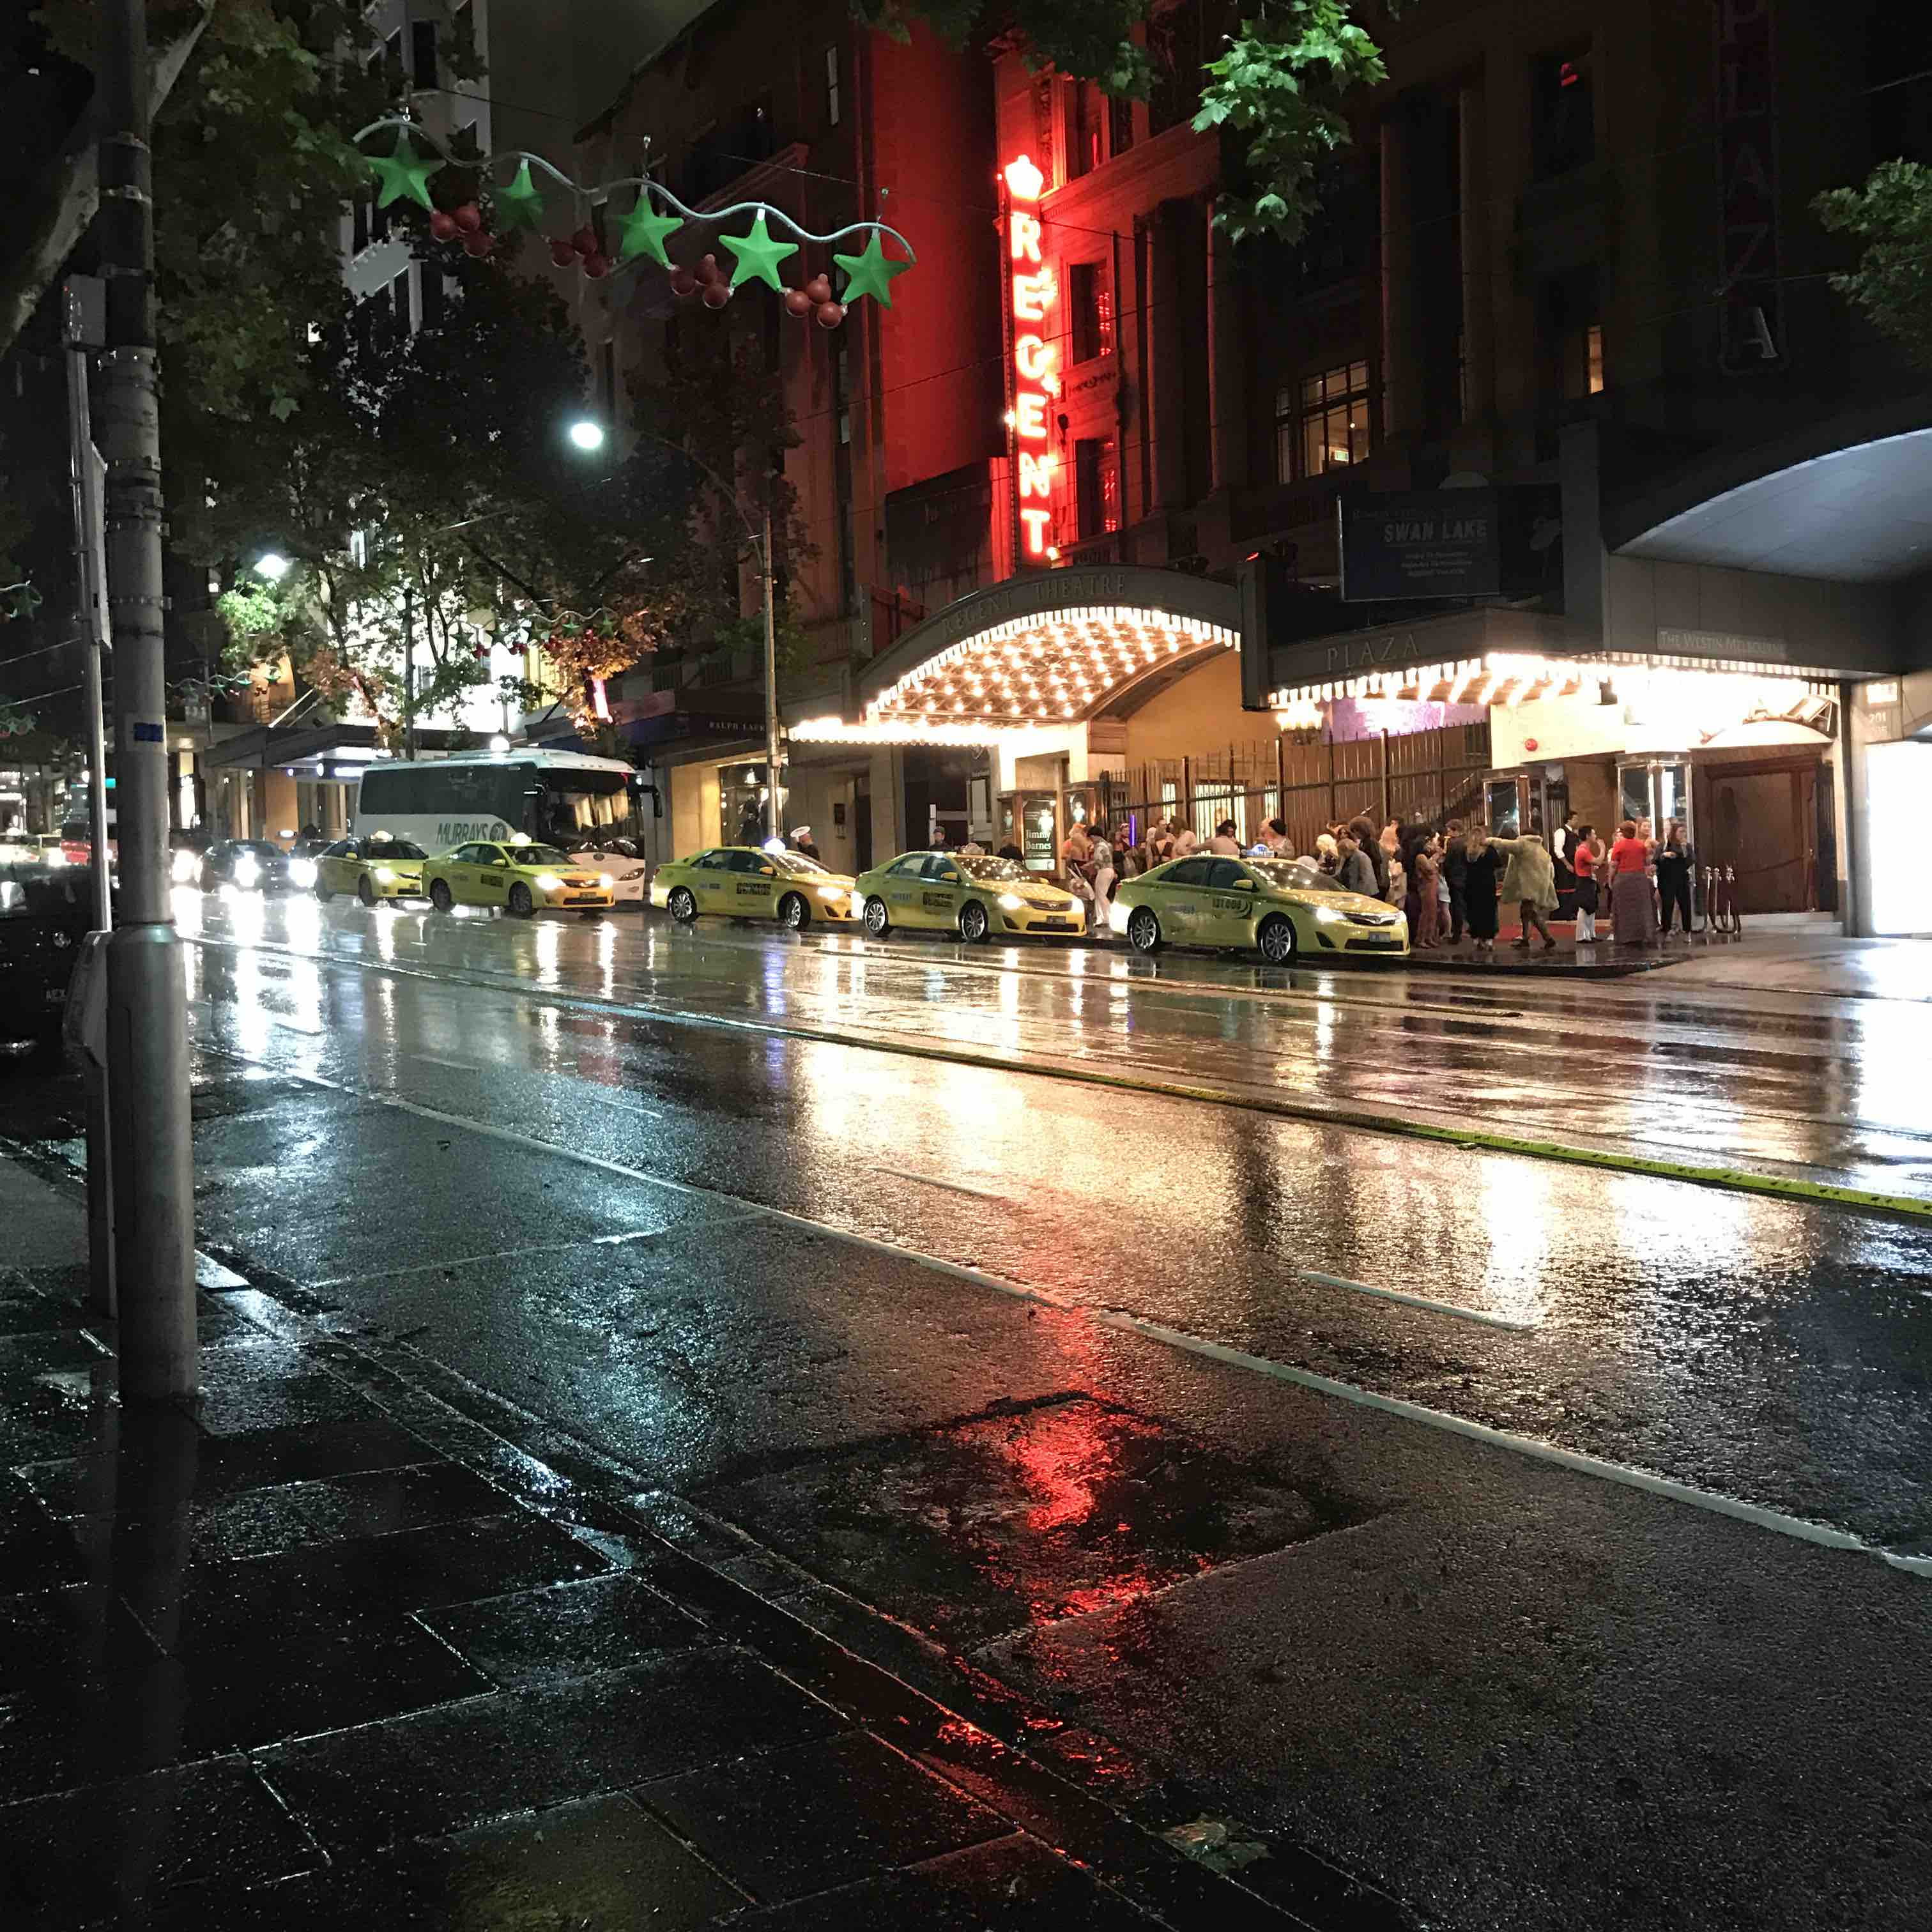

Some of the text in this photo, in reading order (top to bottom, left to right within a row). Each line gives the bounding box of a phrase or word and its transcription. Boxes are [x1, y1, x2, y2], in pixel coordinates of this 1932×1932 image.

[1009, 212, 1051, 553] REGENT
[1384, 519, 1488, 544] SWAN LAKE
[942, 573, 1126, 640] REGENT THEATRE
[1327, 633, 1419, 671] PLAZA
[436, 822, 488, 845] MURRAYS
[1025, 829, 1052, 841] Jimmy
